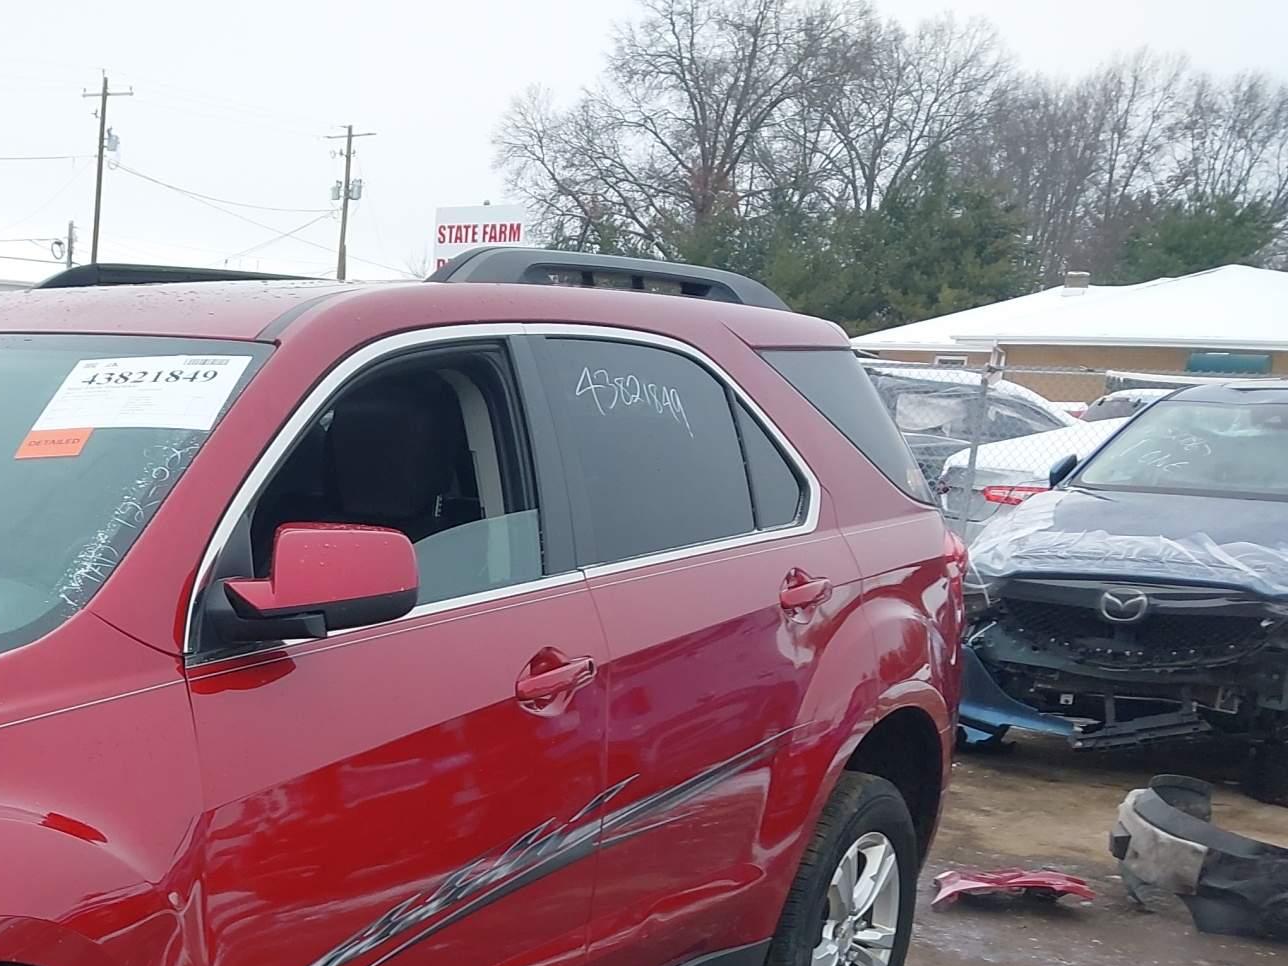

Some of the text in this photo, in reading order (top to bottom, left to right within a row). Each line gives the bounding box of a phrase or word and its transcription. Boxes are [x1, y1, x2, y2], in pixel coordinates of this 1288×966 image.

[438, 223, 521, 244] STATE FARM
[82, 369, 218, 386] 43821849
[576, 367, 693, 438] 43821849
[28, 437, 81, 447] DETAILED
